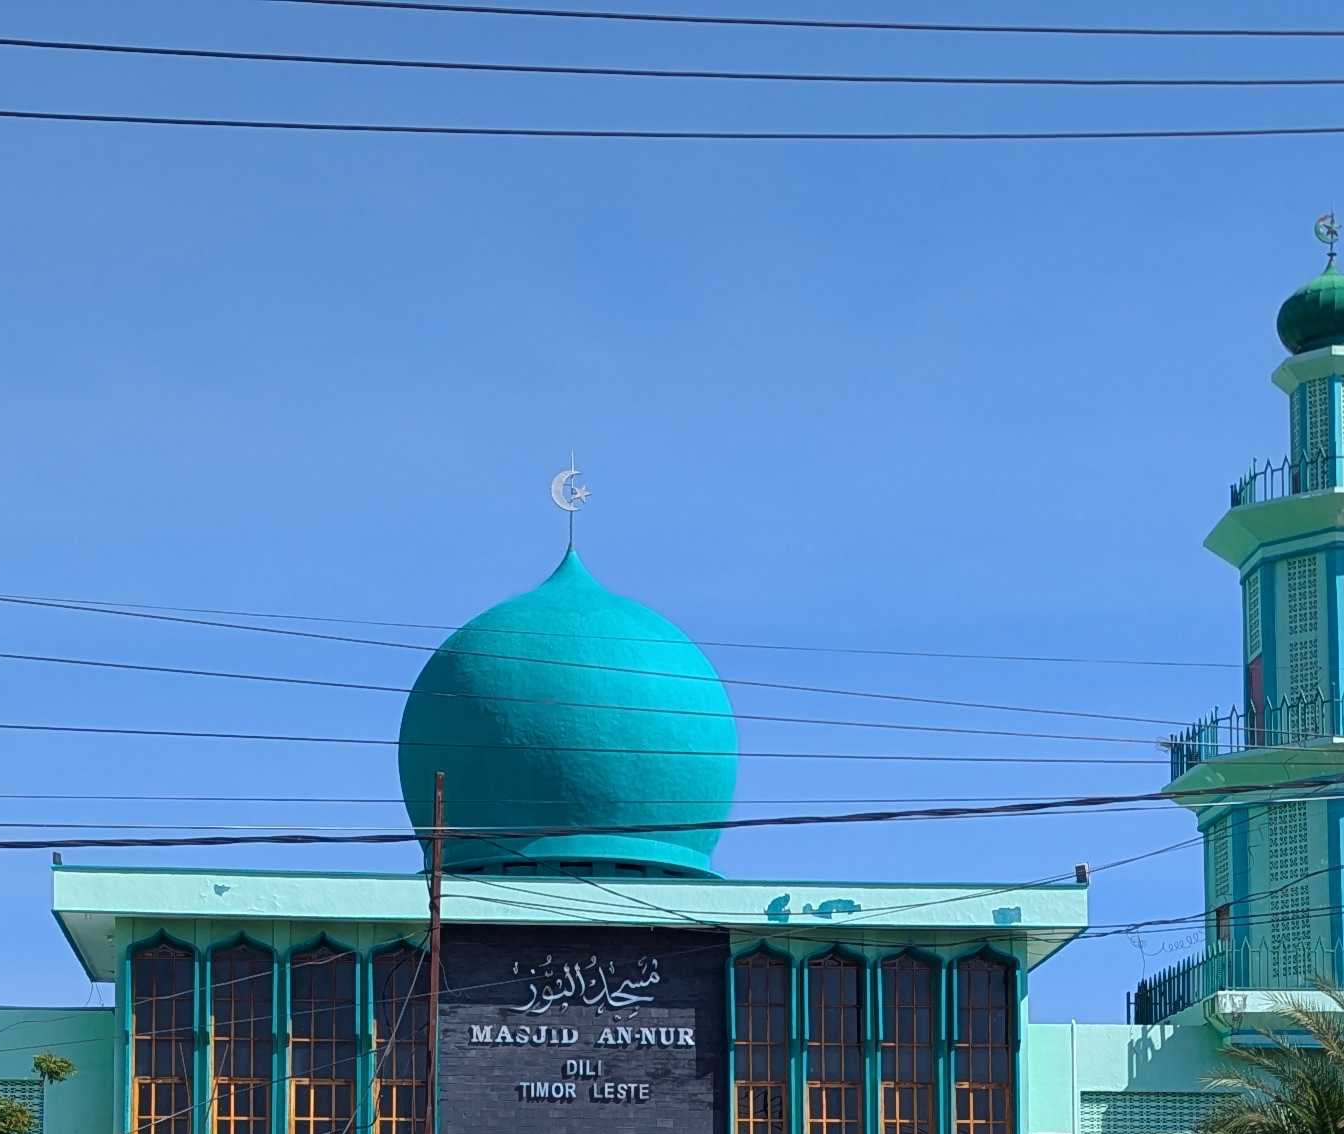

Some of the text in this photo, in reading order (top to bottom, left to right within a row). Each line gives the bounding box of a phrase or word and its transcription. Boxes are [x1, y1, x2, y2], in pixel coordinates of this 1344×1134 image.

[470, 1024, 696, 1047] MASJID AN-NUR
[566, 1059, 602, 1077] DILI
[520, 1081, 650, 1100] TIMOR LESTE
